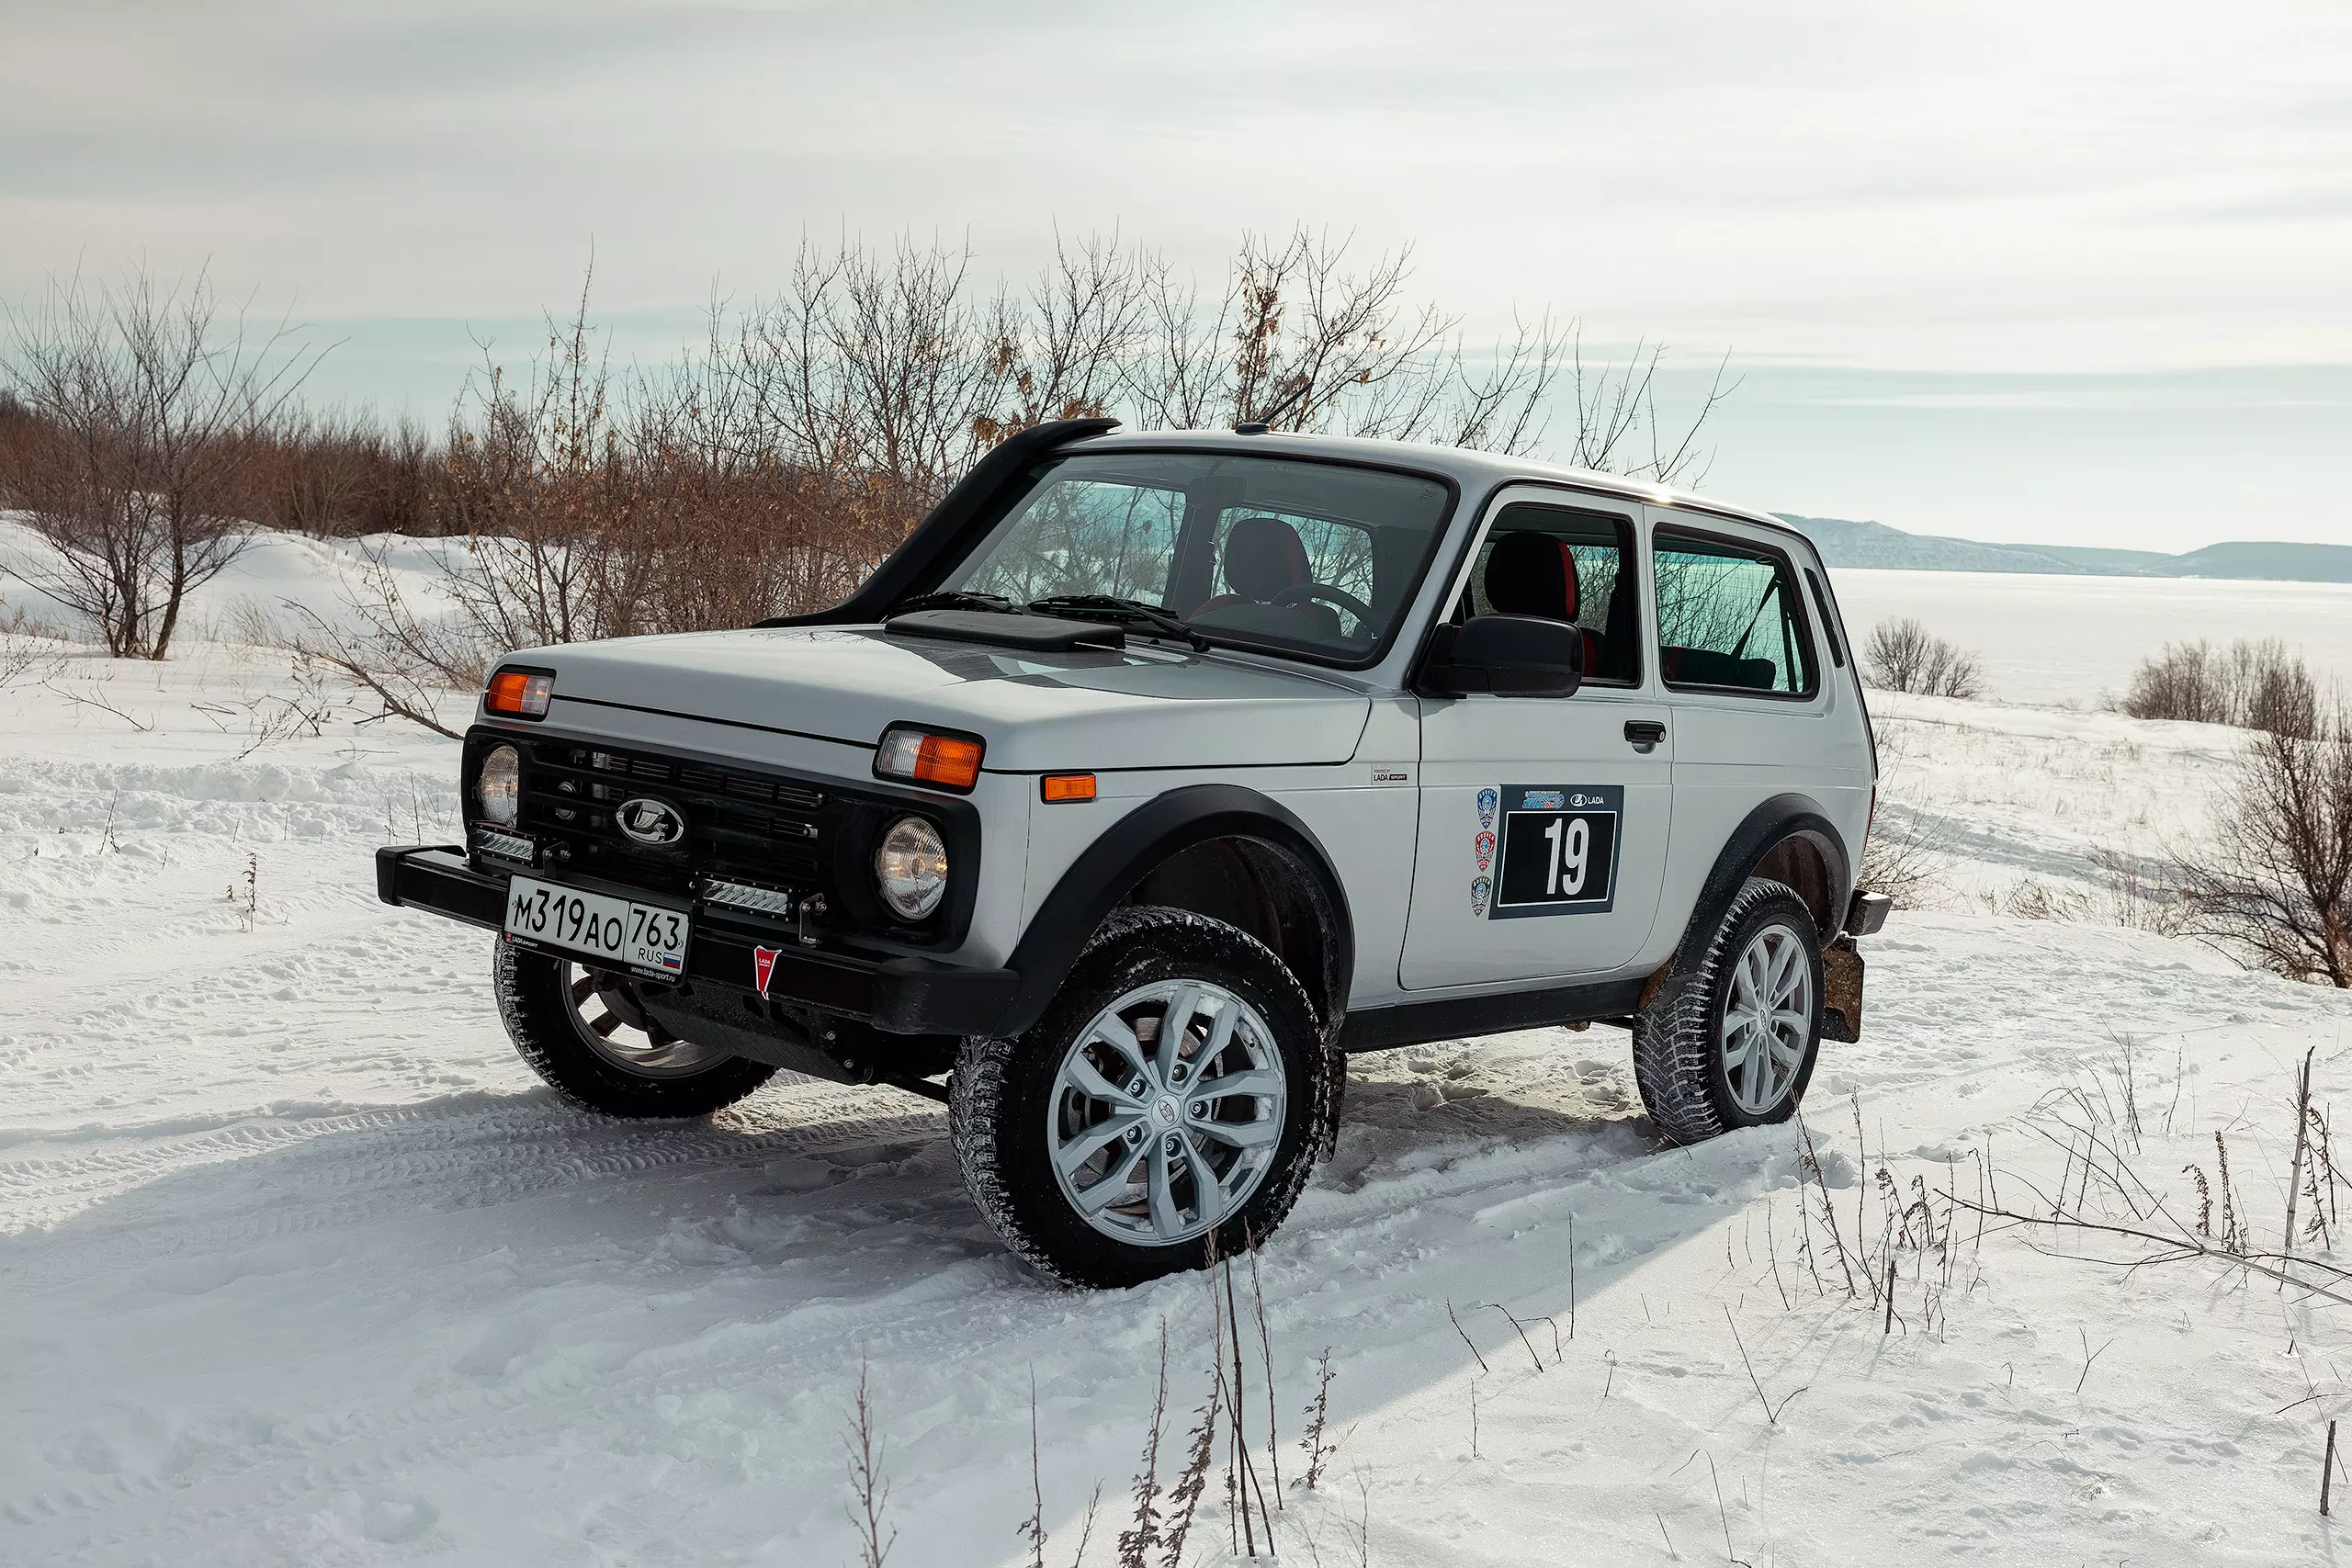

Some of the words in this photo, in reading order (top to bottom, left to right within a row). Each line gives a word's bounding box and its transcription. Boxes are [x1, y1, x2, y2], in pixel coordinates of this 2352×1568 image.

[1588, 796, 1604, 805] LADA
[1544, 818, 1589, 896] 19
[631, 908, 681, 951] 763
[638, 947, 662, 964] RUS
[630, 966, 676, 983] www.lada-sport.ru
